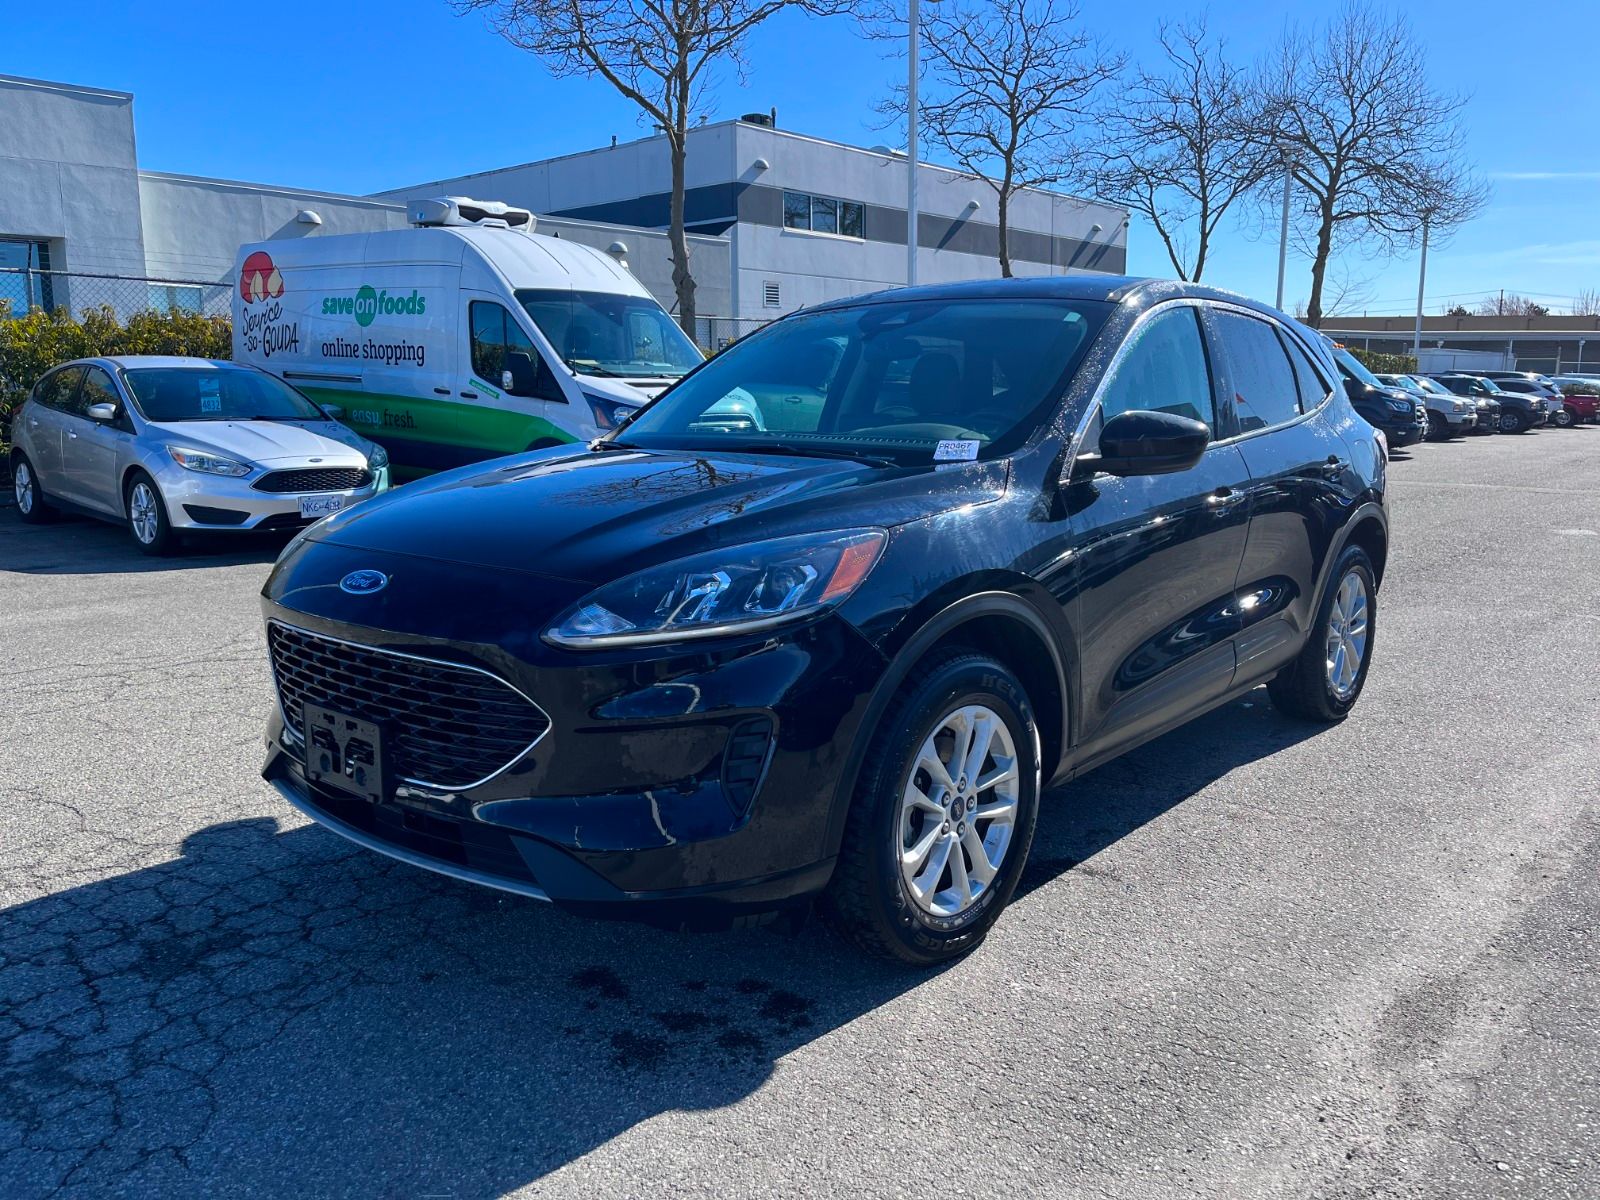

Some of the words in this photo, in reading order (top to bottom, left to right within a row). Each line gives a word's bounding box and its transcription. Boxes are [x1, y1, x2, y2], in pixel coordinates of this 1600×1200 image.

[378, 289, 426, 315] foods
[242, 301, 283, 336] Service
[321, 337, 360, 359] online
[362, 338, 425, 367] shopping
